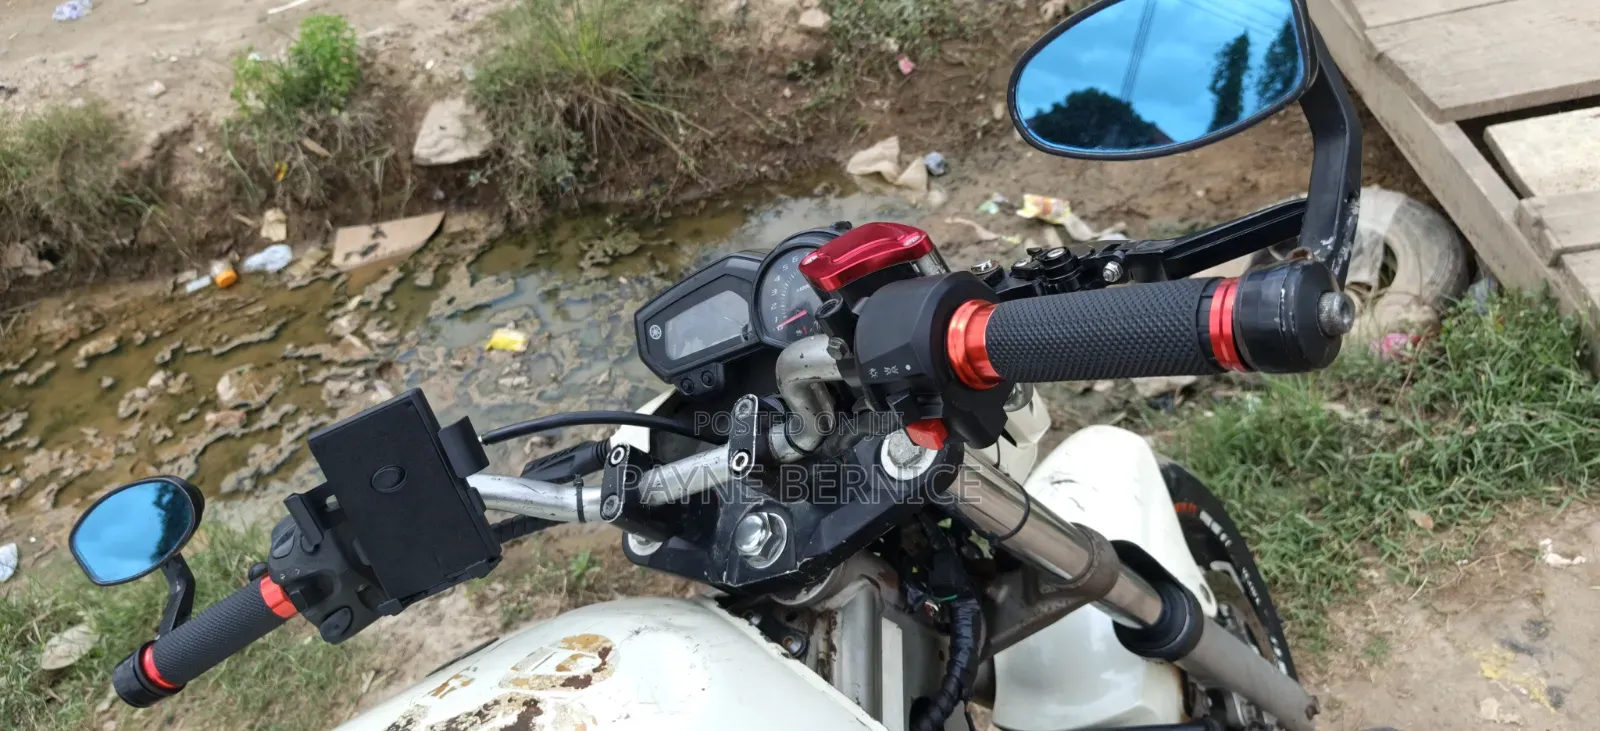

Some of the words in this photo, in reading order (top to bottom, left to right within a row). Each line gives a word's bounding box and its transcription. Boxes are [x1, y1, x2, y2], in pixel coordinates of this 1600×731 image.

[782, 263, 789, 272] 5
[770, 288, 777, 297] 3
[770, 302, 777, 311] 2
